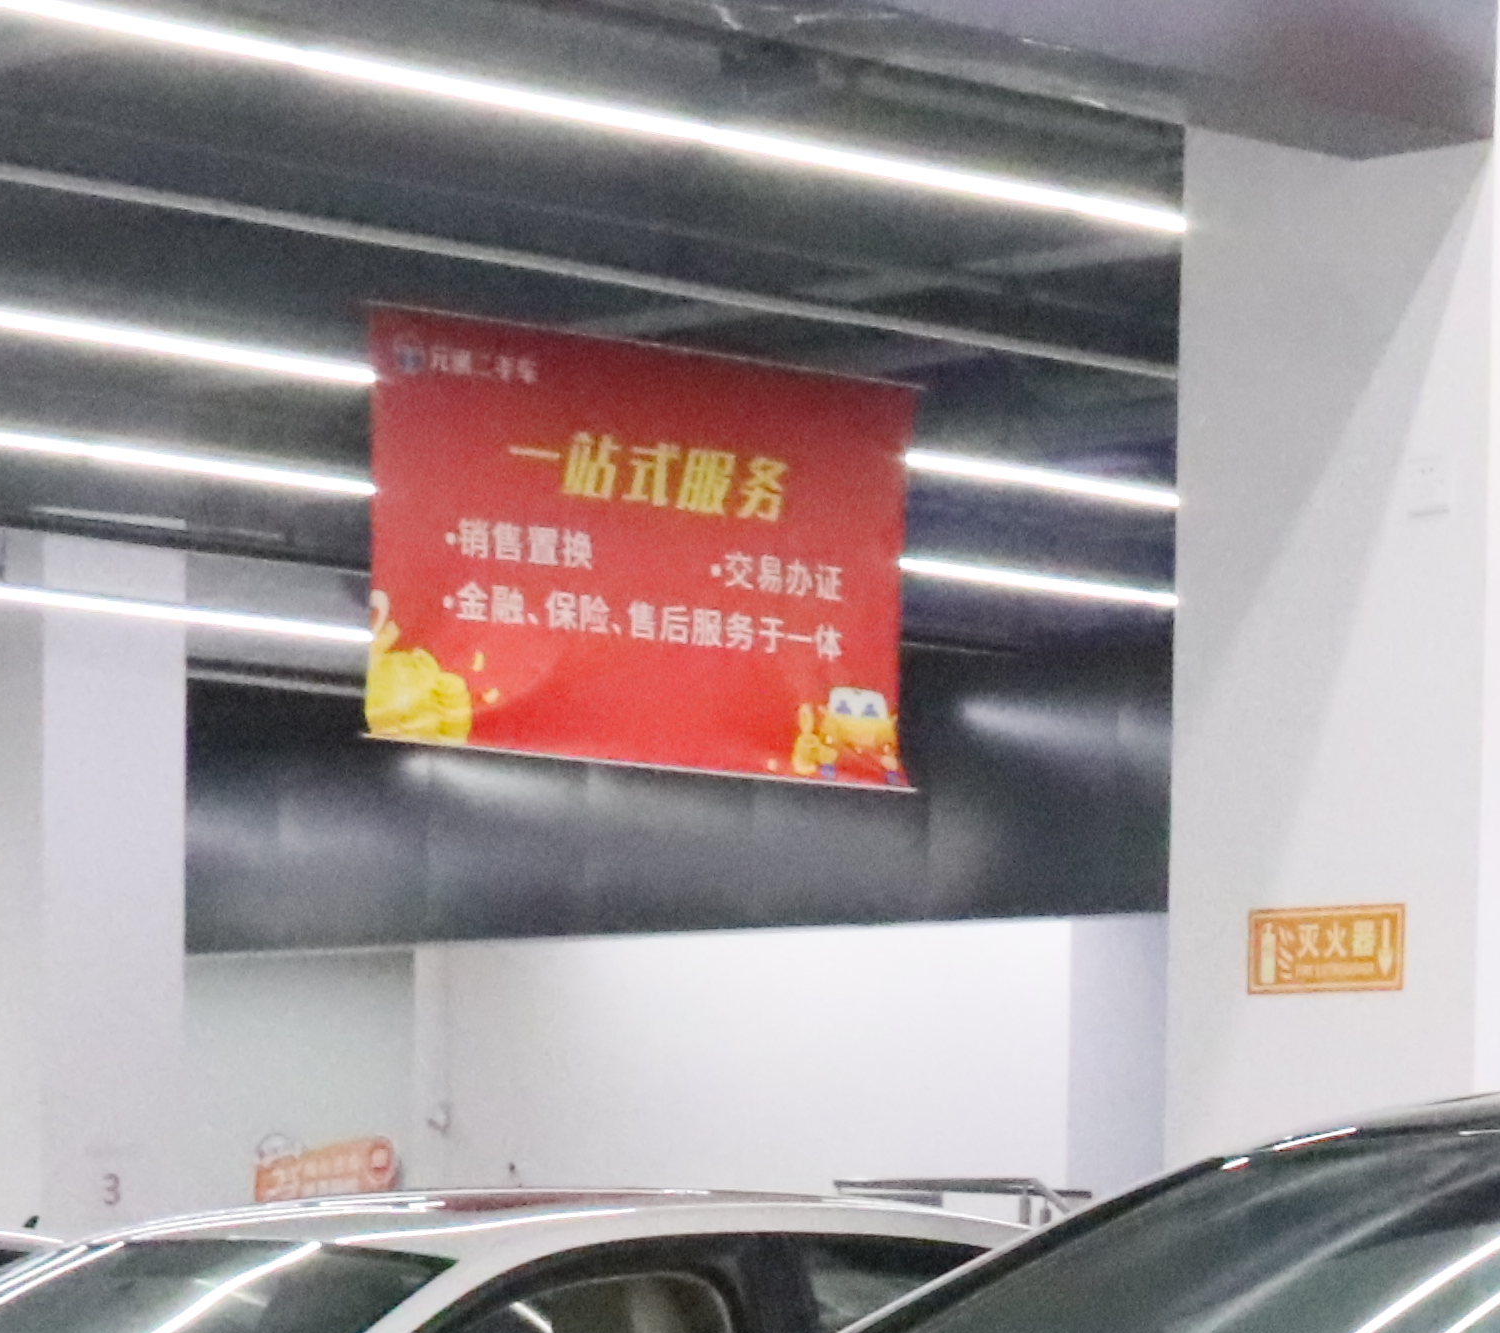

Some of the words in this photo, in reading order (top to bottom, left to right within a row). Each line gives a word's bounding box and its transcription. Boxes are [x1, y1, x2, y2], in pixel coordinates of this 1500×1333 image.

[509, 431, 788, 522] 一站式服务
[457, 517, 594, 570] 销售置换
[723, 550, 843, 601] 交易办证
[454, 581, 843, 662] 金融、保险、售后服务于一体
[1297, 919, 1375, 958] 灭火器
